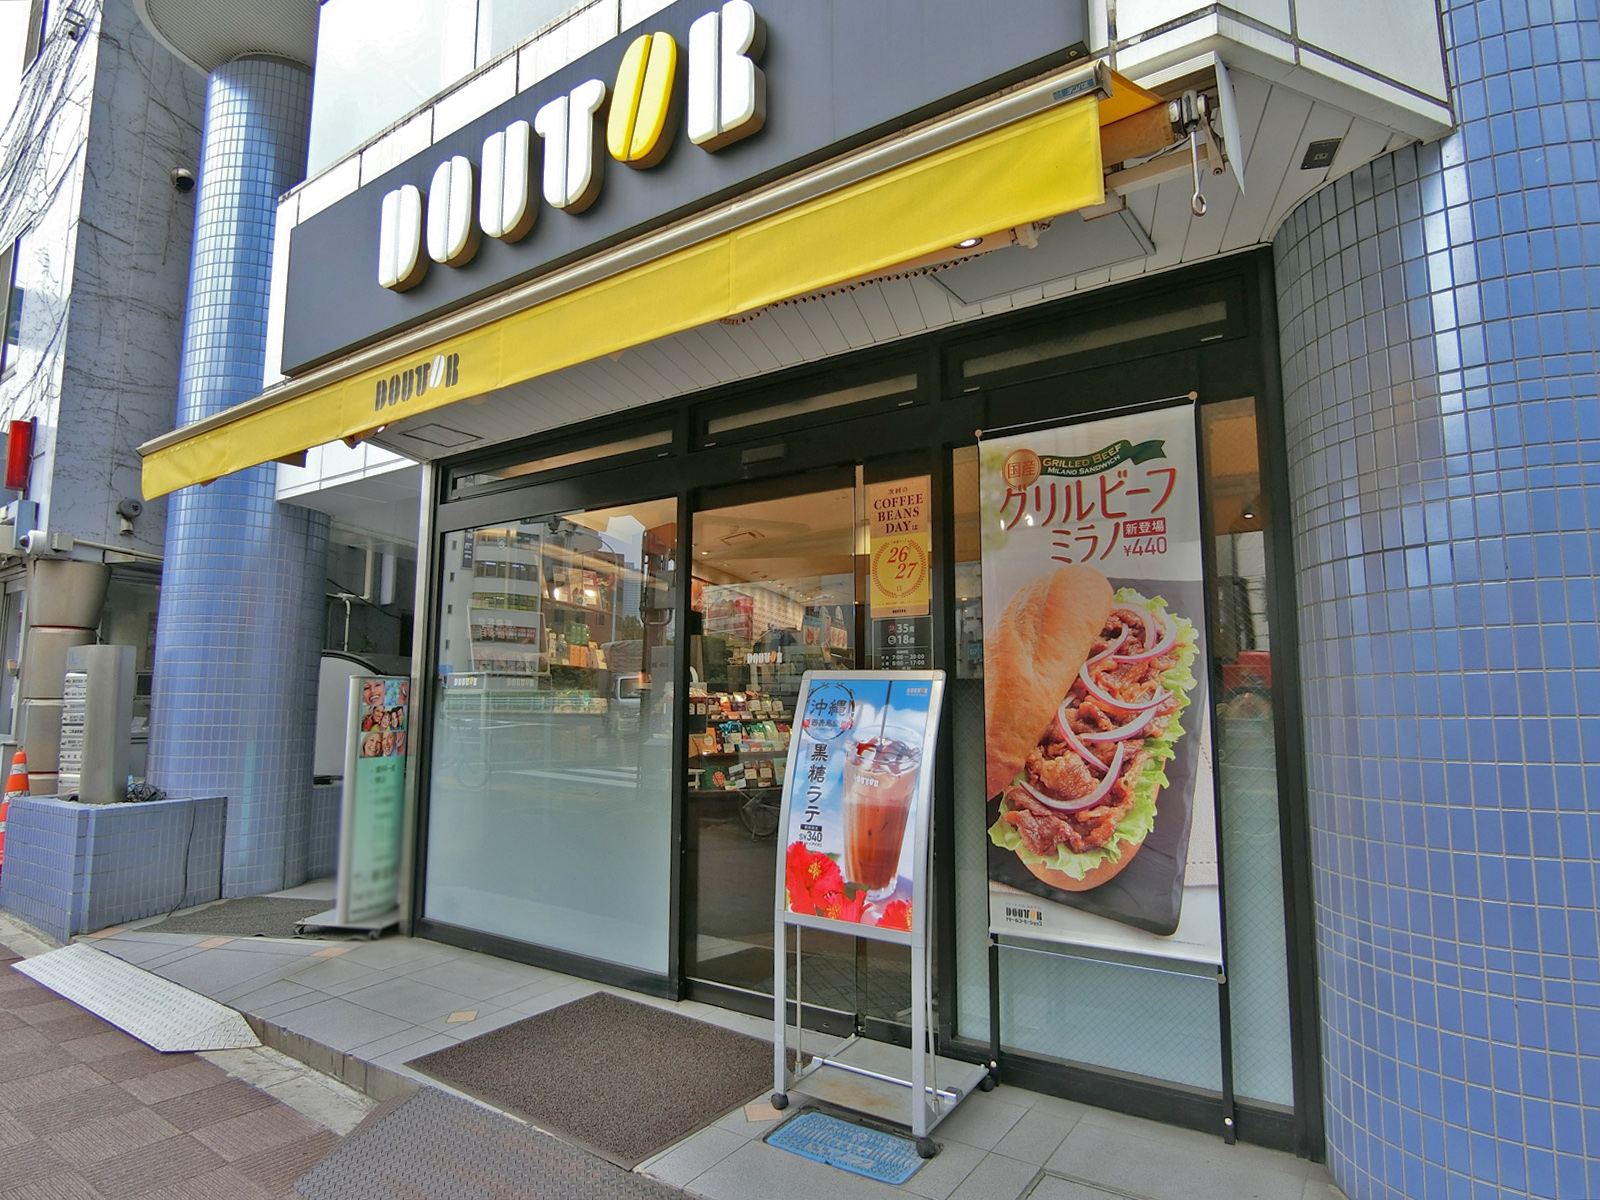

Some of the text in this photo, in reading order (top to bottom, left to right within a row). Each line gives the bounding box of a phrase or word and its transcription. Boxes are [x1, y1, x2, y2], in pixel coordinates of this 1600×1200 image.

[378, 0, 765, 291] DOUTOR
[374, 353, 460, 412] DOUTOR
[1042, 443, 1122, 468] GRILLED BEEF
[1047, 454, 1121, 476] MILANO SANDWICH
[1007, 460, 1036, 479] 国産
[873, 493, 924, 510] COFFEE
[1000, 468, 1177, 531] グリルビーフ
[877, 506, 920, 522] BEANS
[1125, 520, 1165, 535] 新登場
[1051, 521, 1120, 563] ミラノ
[1123, 536, 1168, 557] ¥440
[887, 545, 909, 563] 26
[895, 562, 918, 579] 27
[747, 651, 782, 664] DOUTOR
[809, 699, 847, 717] 沖縄
[804, 743, 829, 823] 黒糖ラテ
[1006, 907, 1042, 920] DOUTOR
